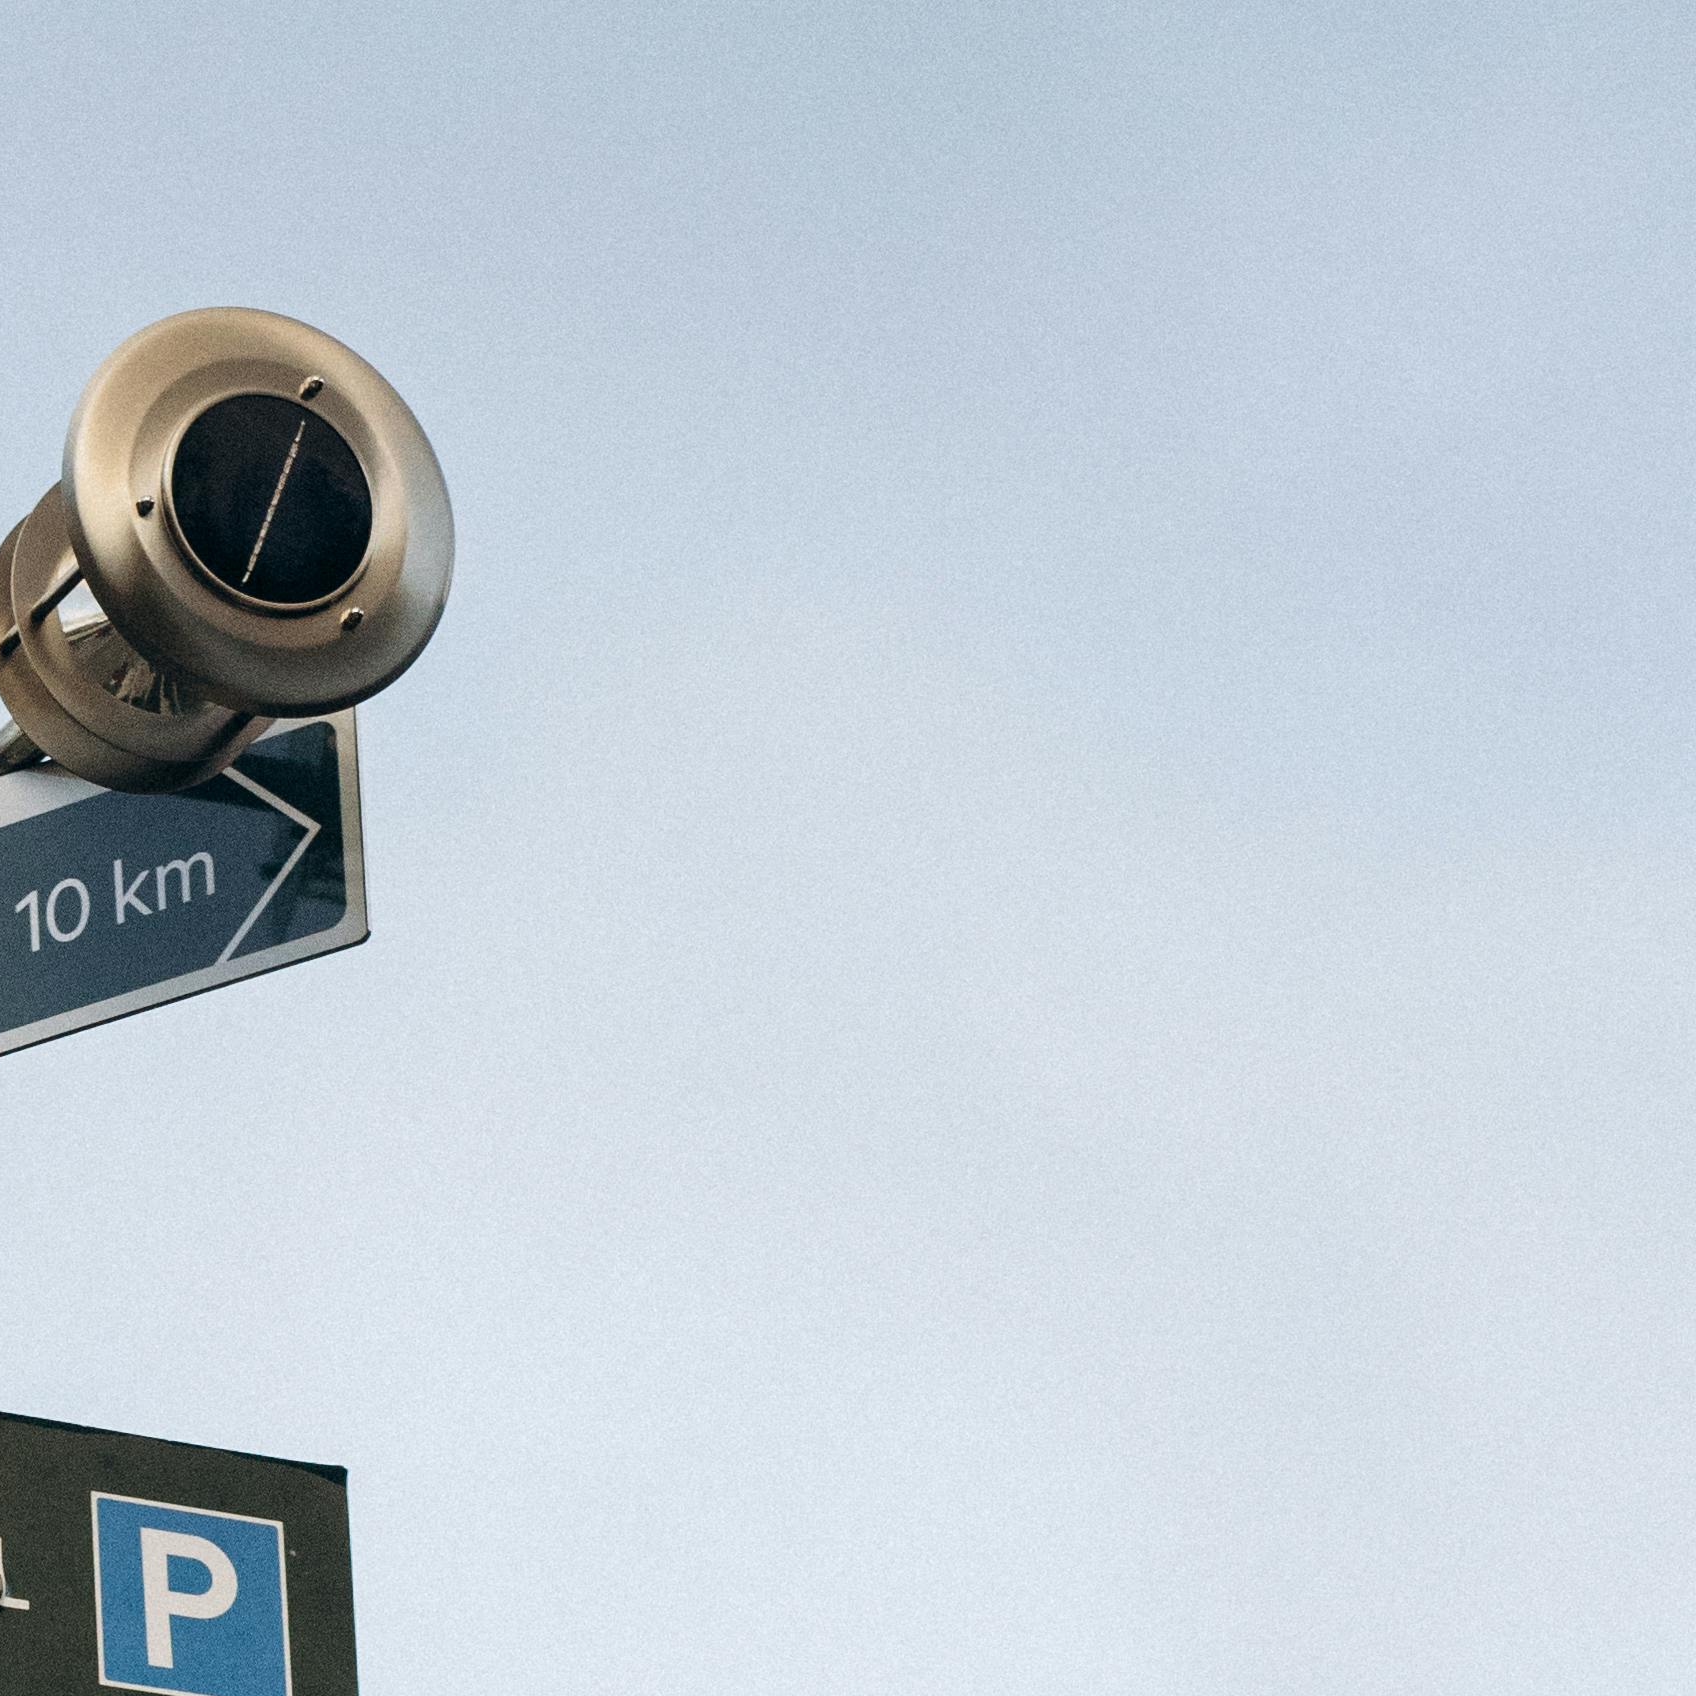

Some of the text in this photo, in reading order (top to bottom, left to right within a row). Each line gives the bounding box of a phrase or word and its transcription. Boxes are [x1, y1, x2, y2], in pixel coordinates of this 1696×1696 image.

[15, 849, 215, 952] 10 km
[140, 1527, 239, 1669] P
